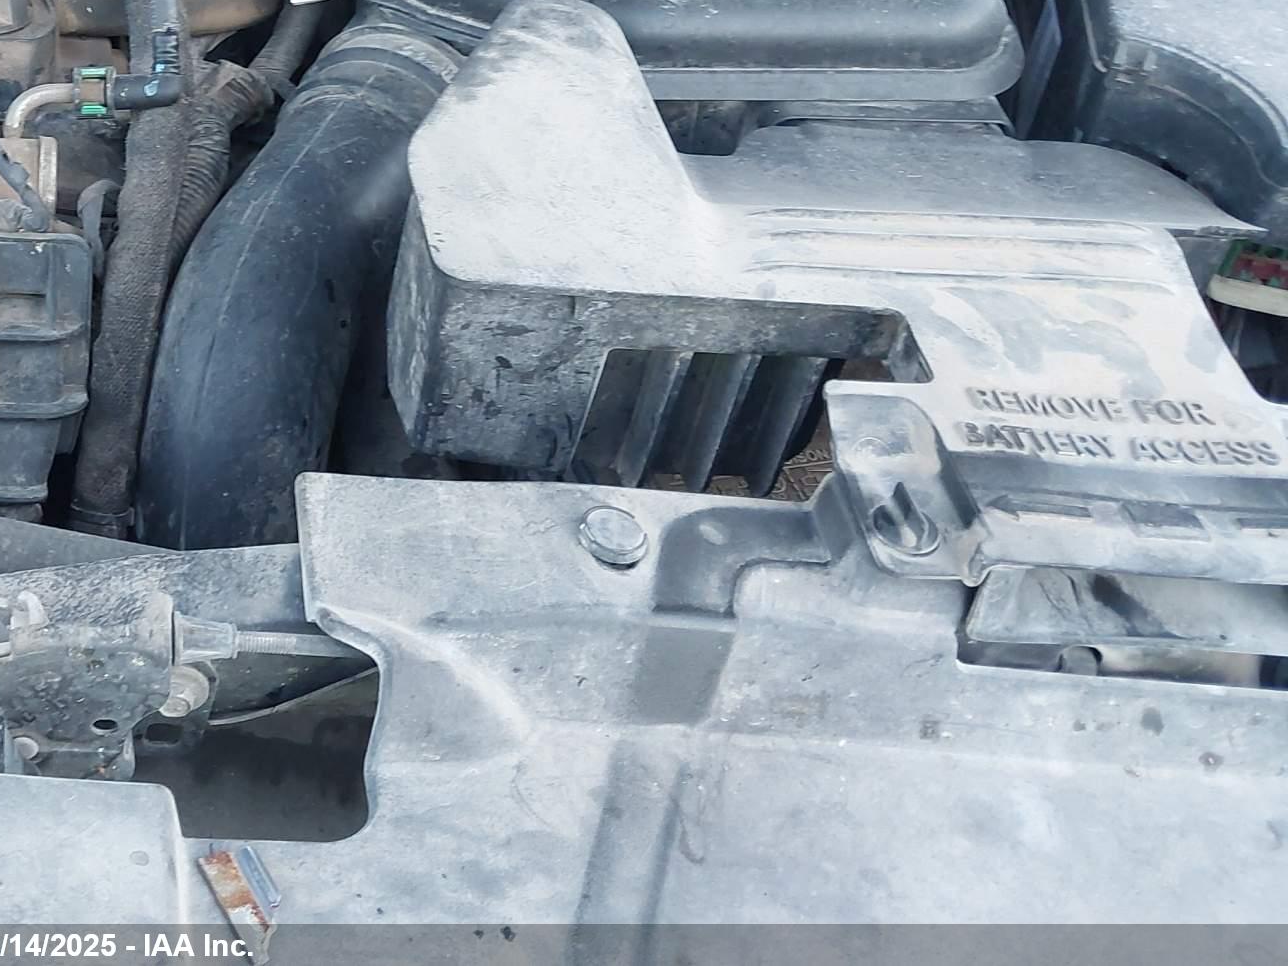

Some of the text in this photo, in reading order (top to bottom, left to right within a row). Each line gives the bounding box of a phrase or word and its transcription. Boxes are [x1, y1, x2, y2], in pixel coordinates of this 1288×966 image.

[967, 387, 1216, 426] REMOVE FOR
[959, 421, 1282, 466] BATTERY ACCESS
